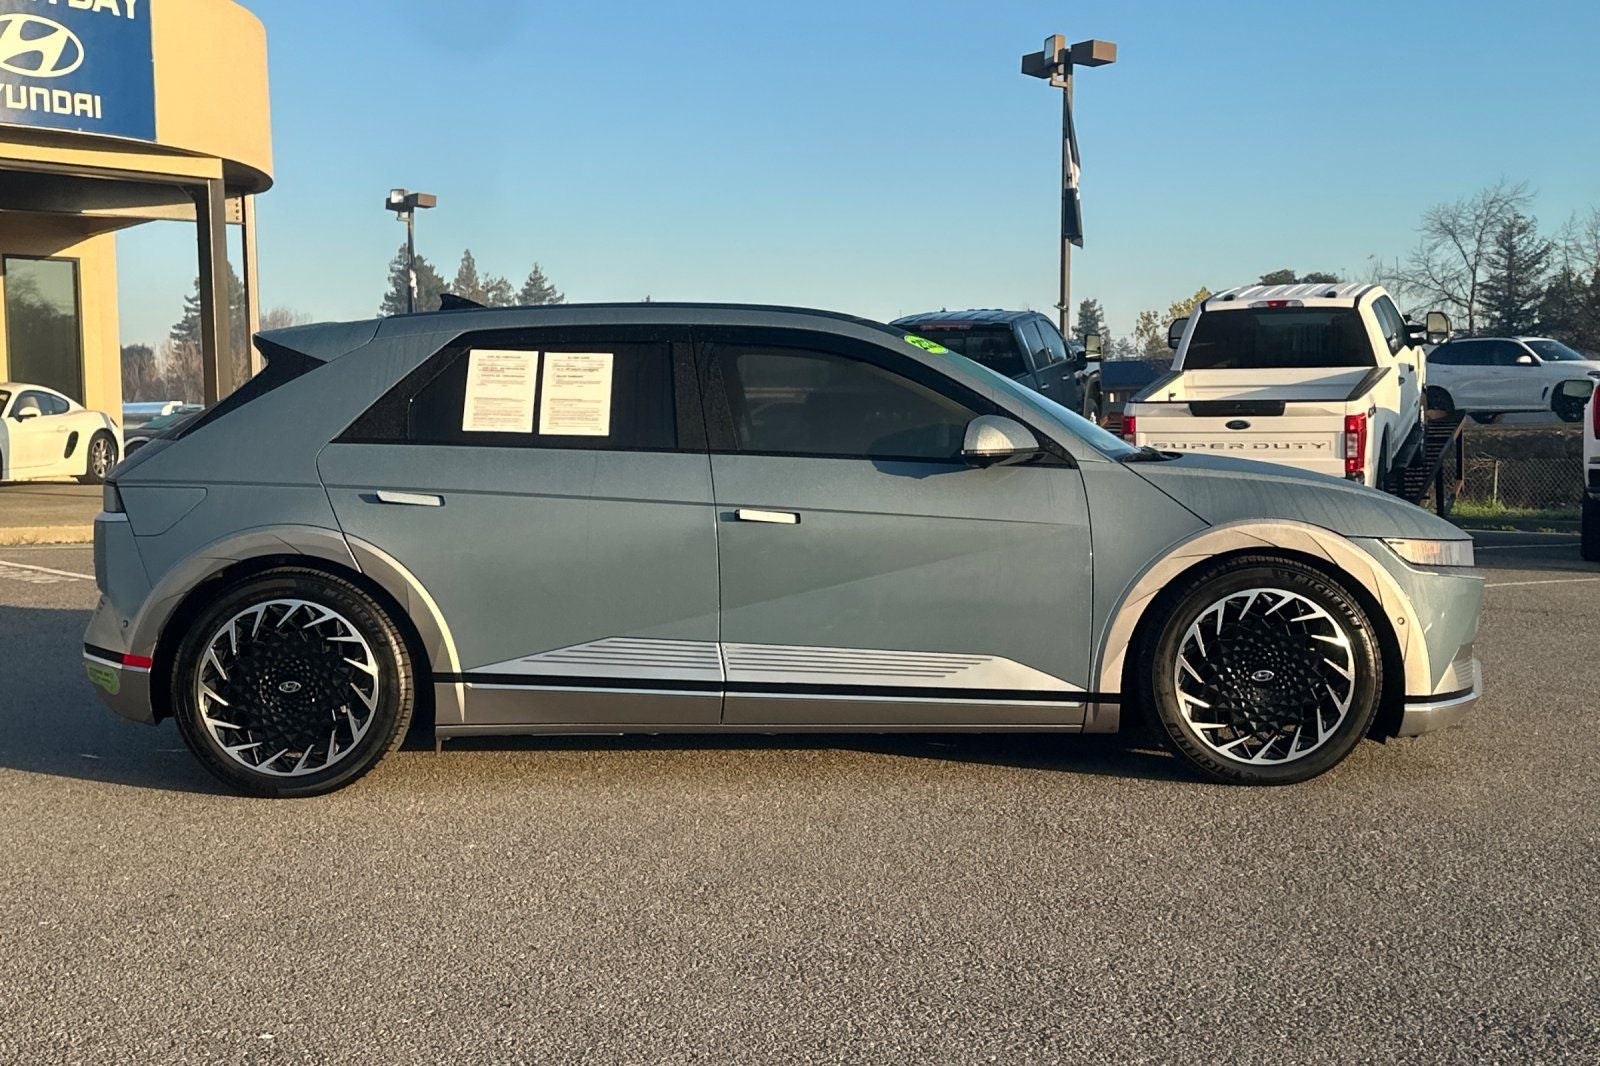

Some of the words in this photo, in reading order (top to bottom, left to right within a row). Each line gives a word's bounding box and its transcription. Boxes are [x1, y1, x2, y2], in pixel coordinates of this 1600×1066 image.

[68, 0, 136, 20] AY
[0, 83, 102, 119] UNDAI
[1152, 442, 1245, 450] SUPER
[1253, 442, 1327, 450] DUTY
[1294, 574, 1363, 628] MICHELIN
